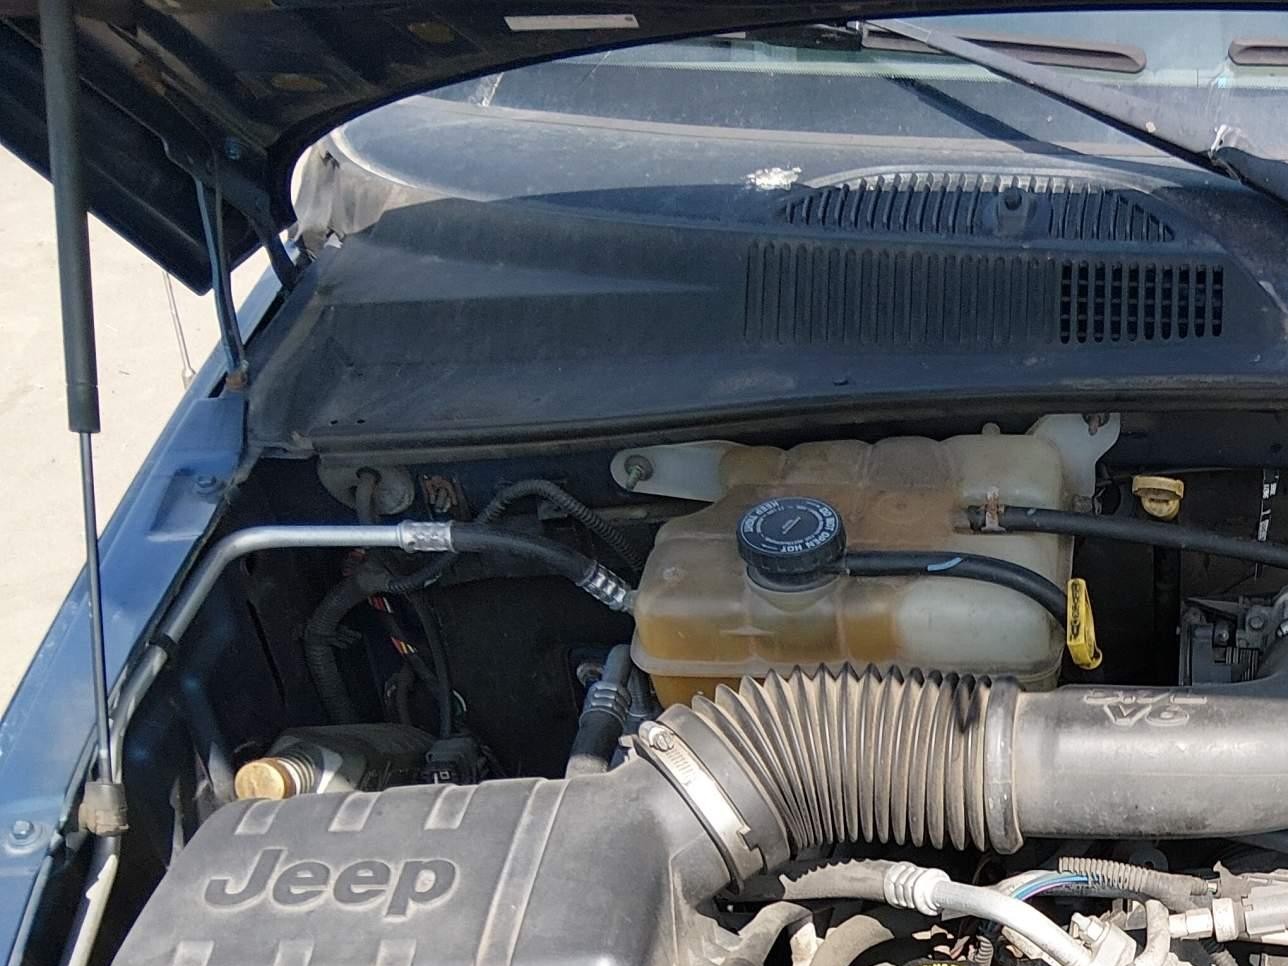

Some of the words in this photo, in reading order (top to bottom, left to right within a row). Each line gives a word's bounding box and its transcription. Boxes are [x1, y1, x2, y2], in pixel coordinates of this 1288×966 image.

[780, 543, 804, 553] HOT
[805, 531, 830, 549] OPEN
[1104, 702, 1190, 728] V6
[203, 847, 460, 922] Jeep
